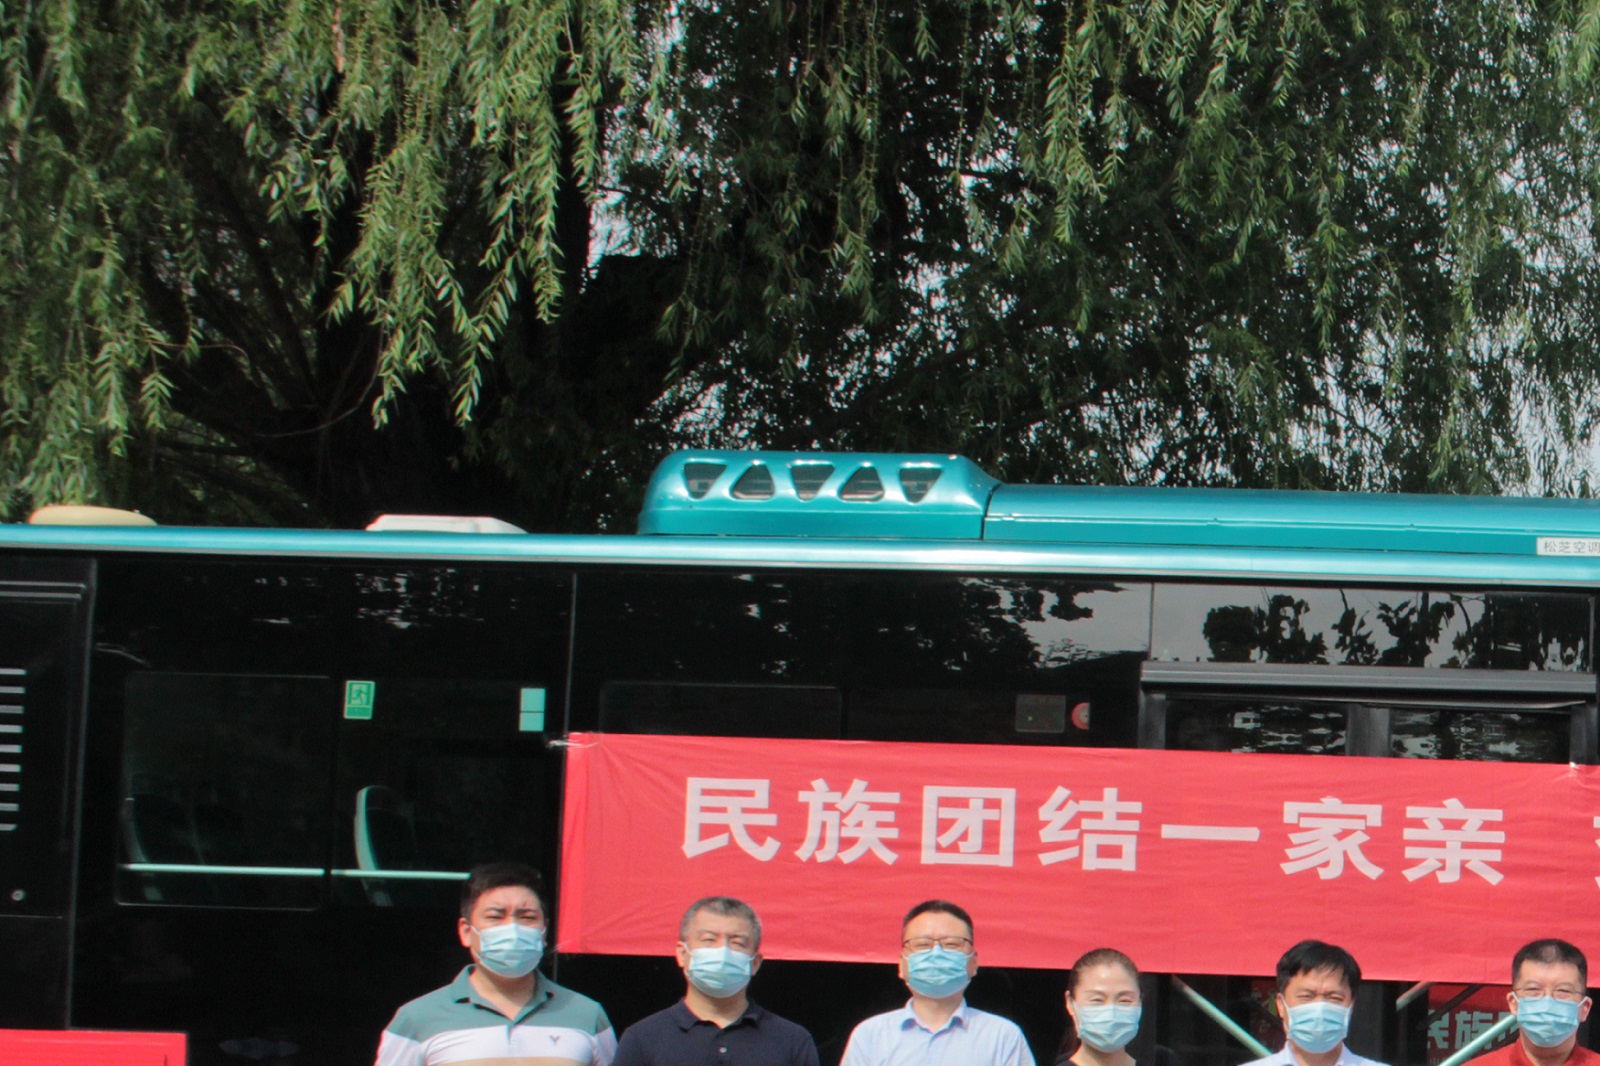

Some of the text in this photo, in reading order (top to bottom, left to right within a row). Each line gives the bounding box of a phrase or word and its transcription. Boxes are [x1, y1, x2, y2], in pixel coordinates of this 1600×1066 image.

[1543, 541, 1600, 554] 松芝空调
[682, 776, 1506, 886] 民族团结一家亲
